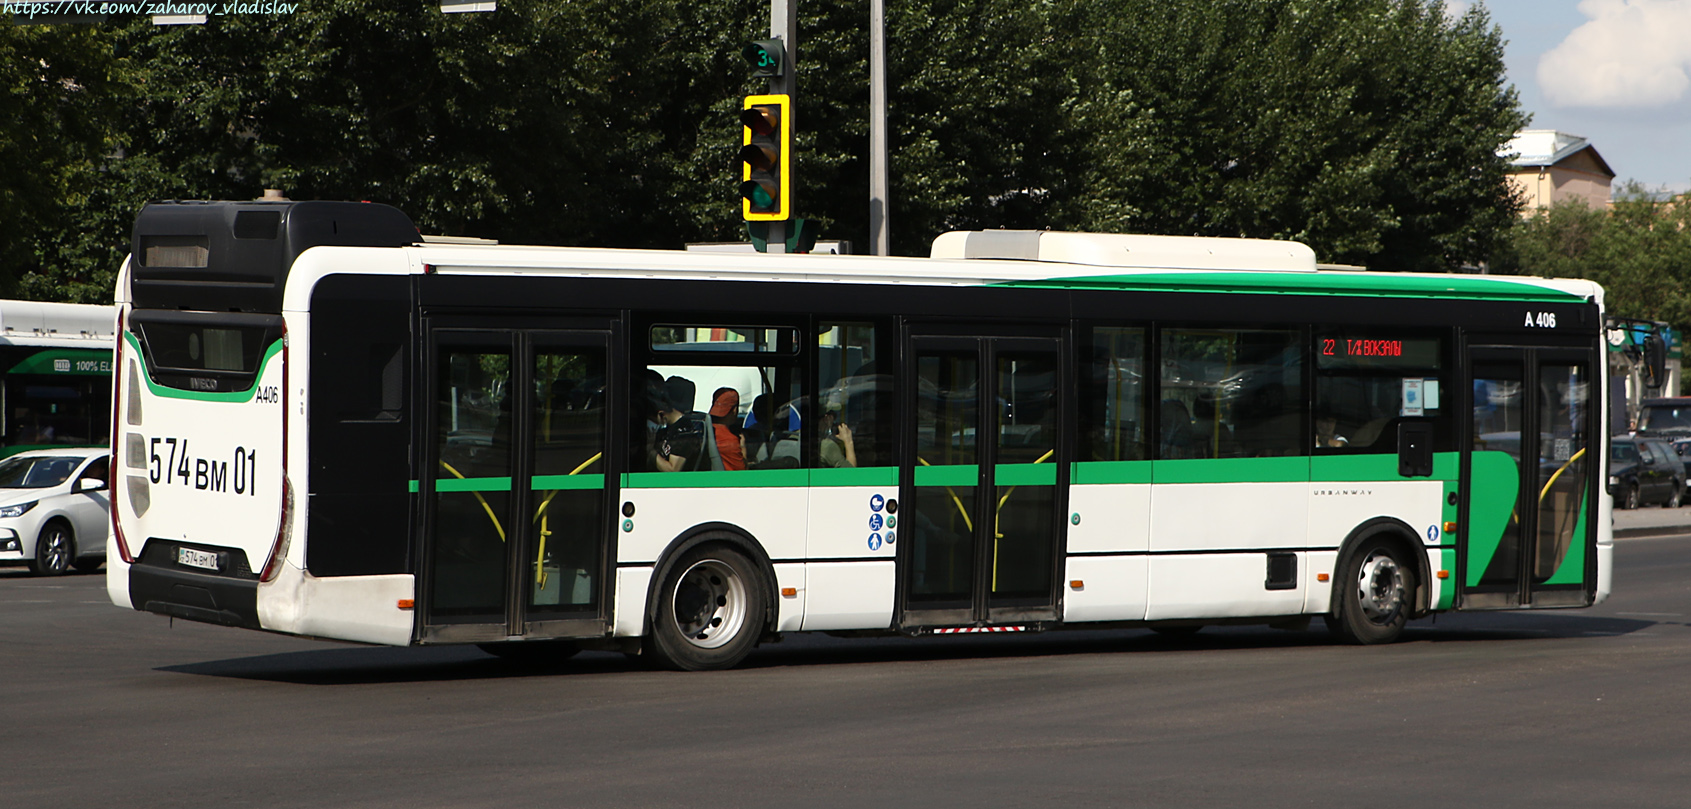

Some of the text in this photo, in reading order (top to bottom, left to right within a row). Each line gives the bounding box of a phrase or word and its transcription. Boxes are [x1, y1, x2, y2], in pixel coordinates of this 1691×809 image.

[1536, 311, 1556, 328] 406
[1323, 339, 1335, 355] 22
[1364, 340, 1402, 356] ВОКЗАЛЫ
[76, 361, 98, 371] 100%
[255, 385, 278, 404] A406
[150, 437, 190, 485] 574
[234, 446, 255, 496] 01
[185, 550, 198, 564] 574
